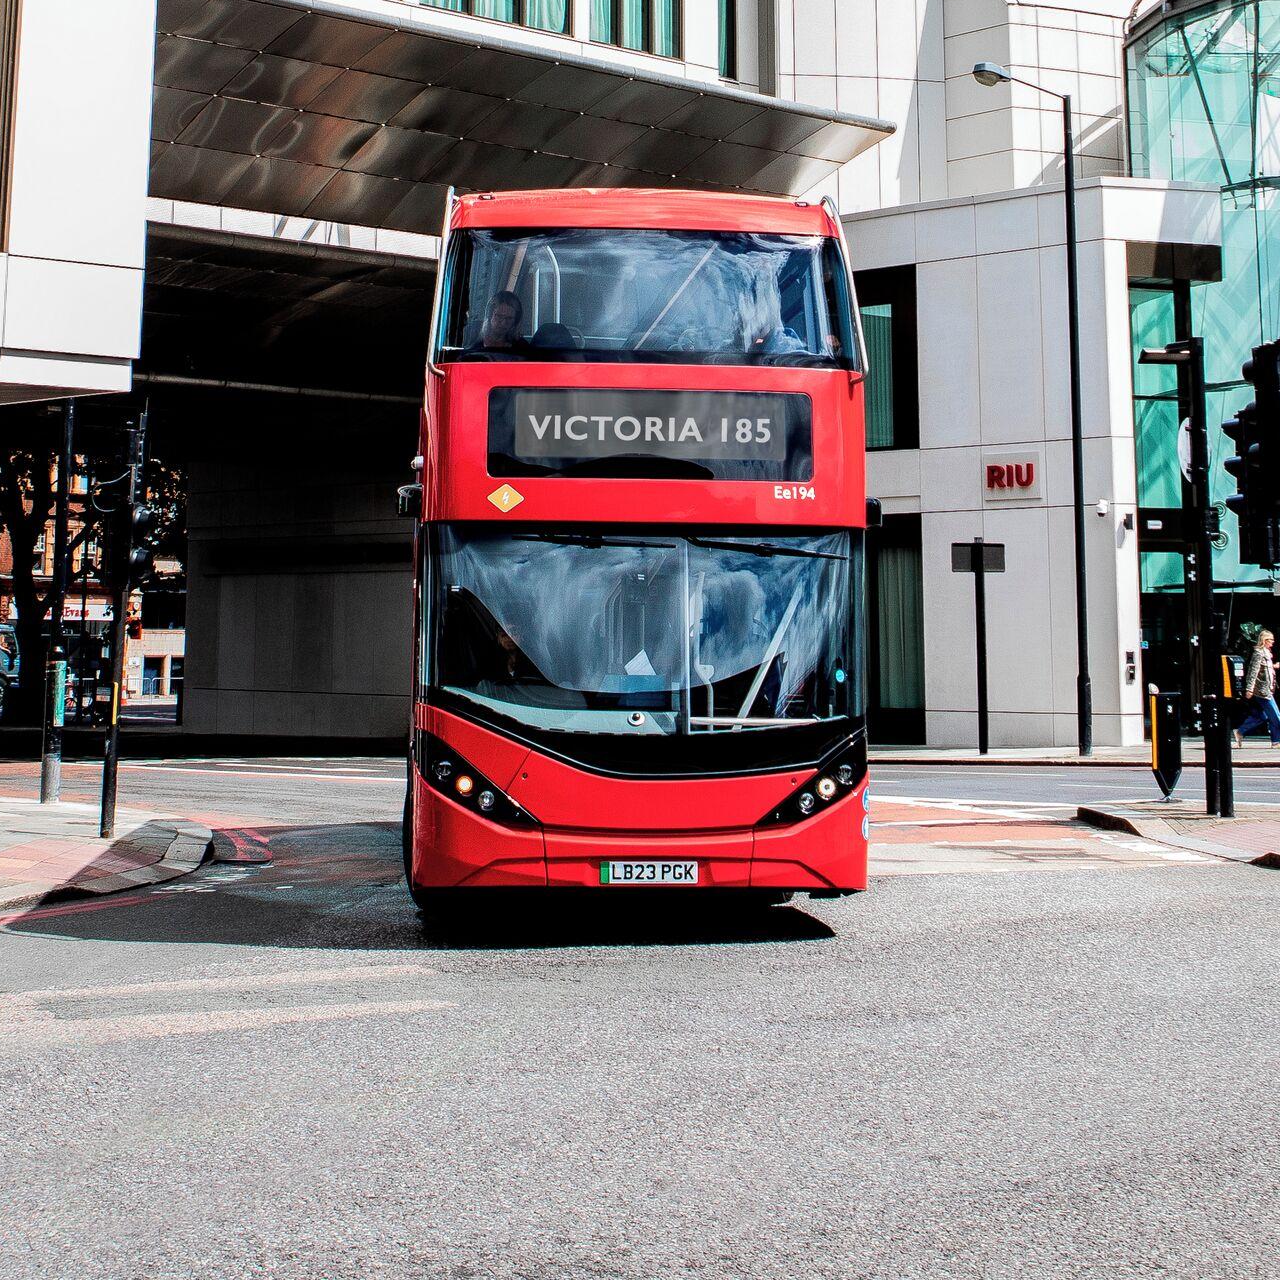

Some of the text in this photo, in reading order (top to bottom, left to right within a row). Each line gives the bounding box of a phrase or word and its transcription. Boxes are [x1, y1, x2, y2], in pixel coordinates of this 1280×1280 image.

[528, 415, 771, 444] VICTORIA 185
[986, 463, 1034, 488] RIU
[774, 486, 816, 501] Ee194
[612, 864, 694, 880] LB23 PGK
